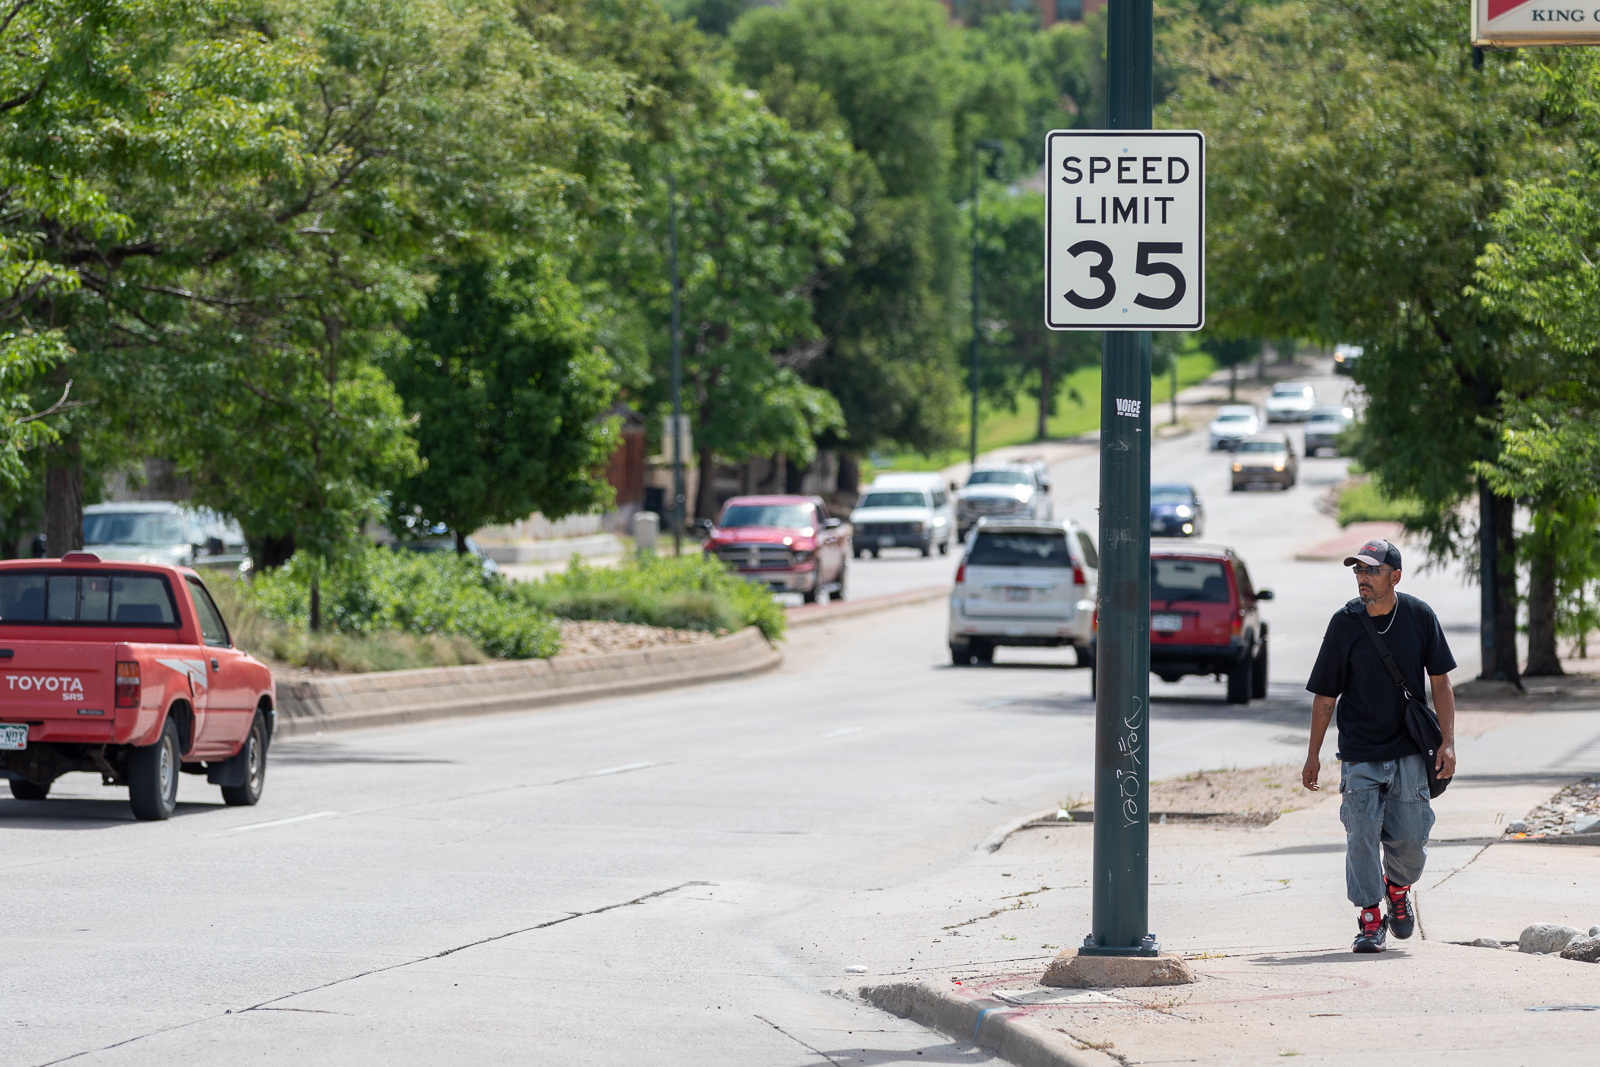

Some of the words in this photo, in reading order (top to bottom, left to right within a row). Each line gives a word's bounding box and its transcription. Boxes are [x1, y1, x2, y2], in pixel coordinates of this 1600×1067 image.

[1531, 9, 1586, 22] KING
[1061, 156, 1190, 184] SPEED
[1075, 196, 1175, 224] LIMIT
[1062, 239, 1187, 311] 35
[5, 675, 84, 692] TOYOTA
